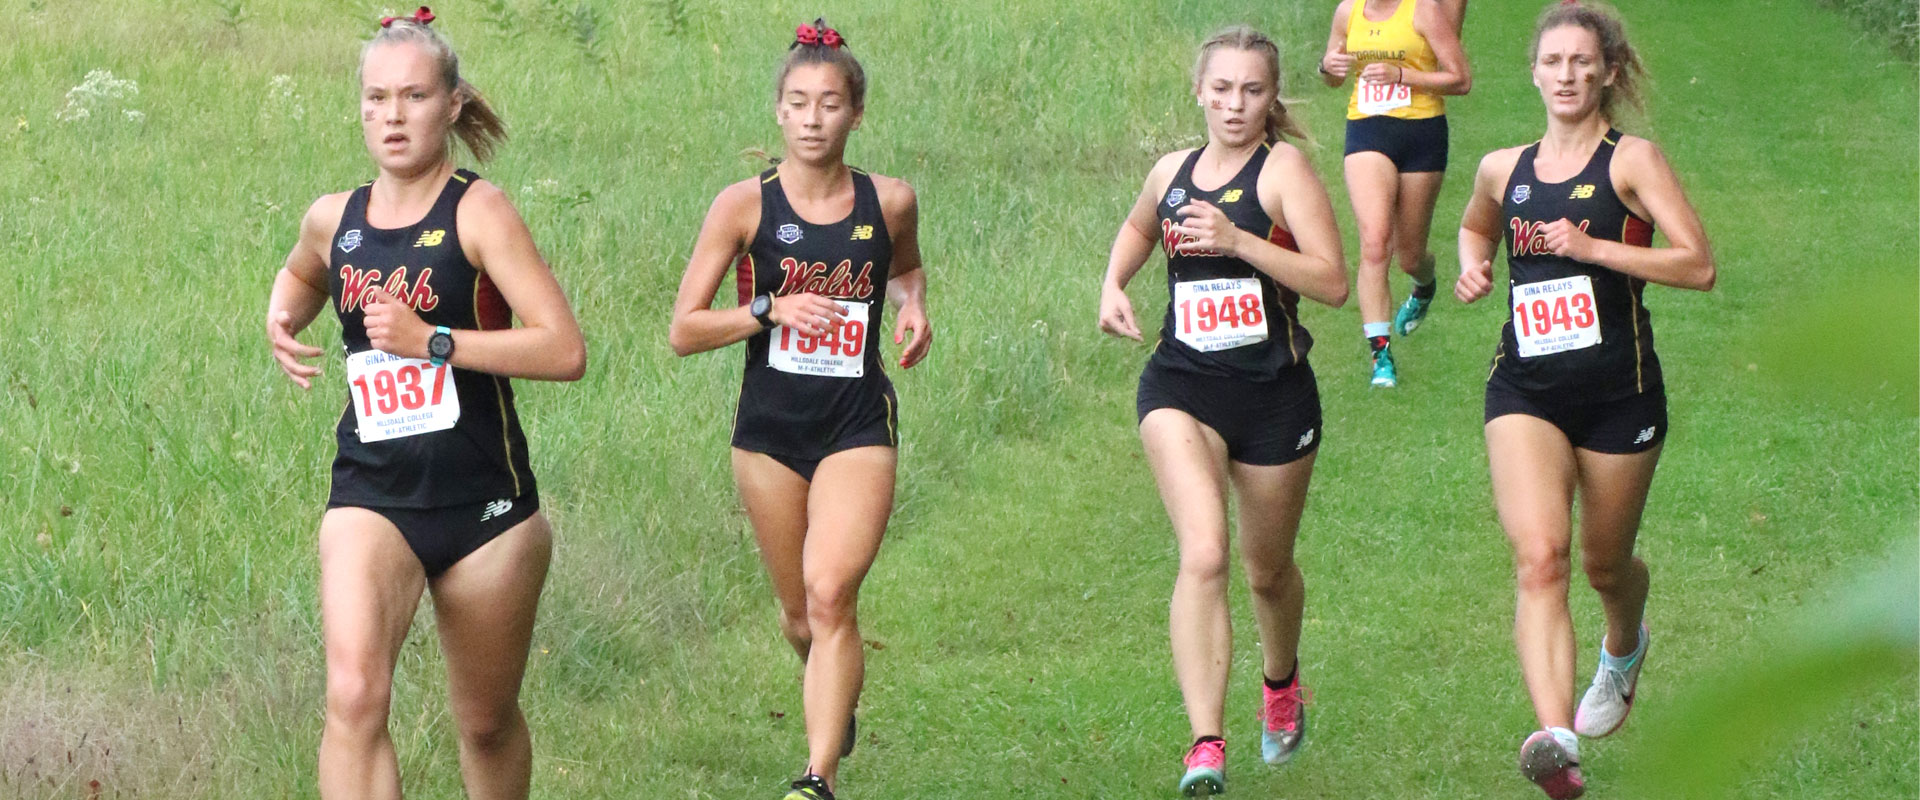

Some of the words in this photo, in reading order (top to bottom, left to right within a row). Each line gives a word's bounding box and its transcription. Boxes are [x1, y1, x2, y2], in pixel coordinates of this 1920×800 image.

[1362, 82, 1409, 103] 1873
[777, 257, 873, 299] Walsh
[1211, 280, 1242, 292] RELAYS
[1524, 285, 1540, 296] GINA
[1542, 281, 1573, 294] RELAYS
[1180, 293, 1263, 334] 1948
[1515, 293, 1595, 337] 1943
[780, 319, 864, 357] 1949
[365, 353, 386, 366] GINA
[353, 362, 447, 417] 1937
